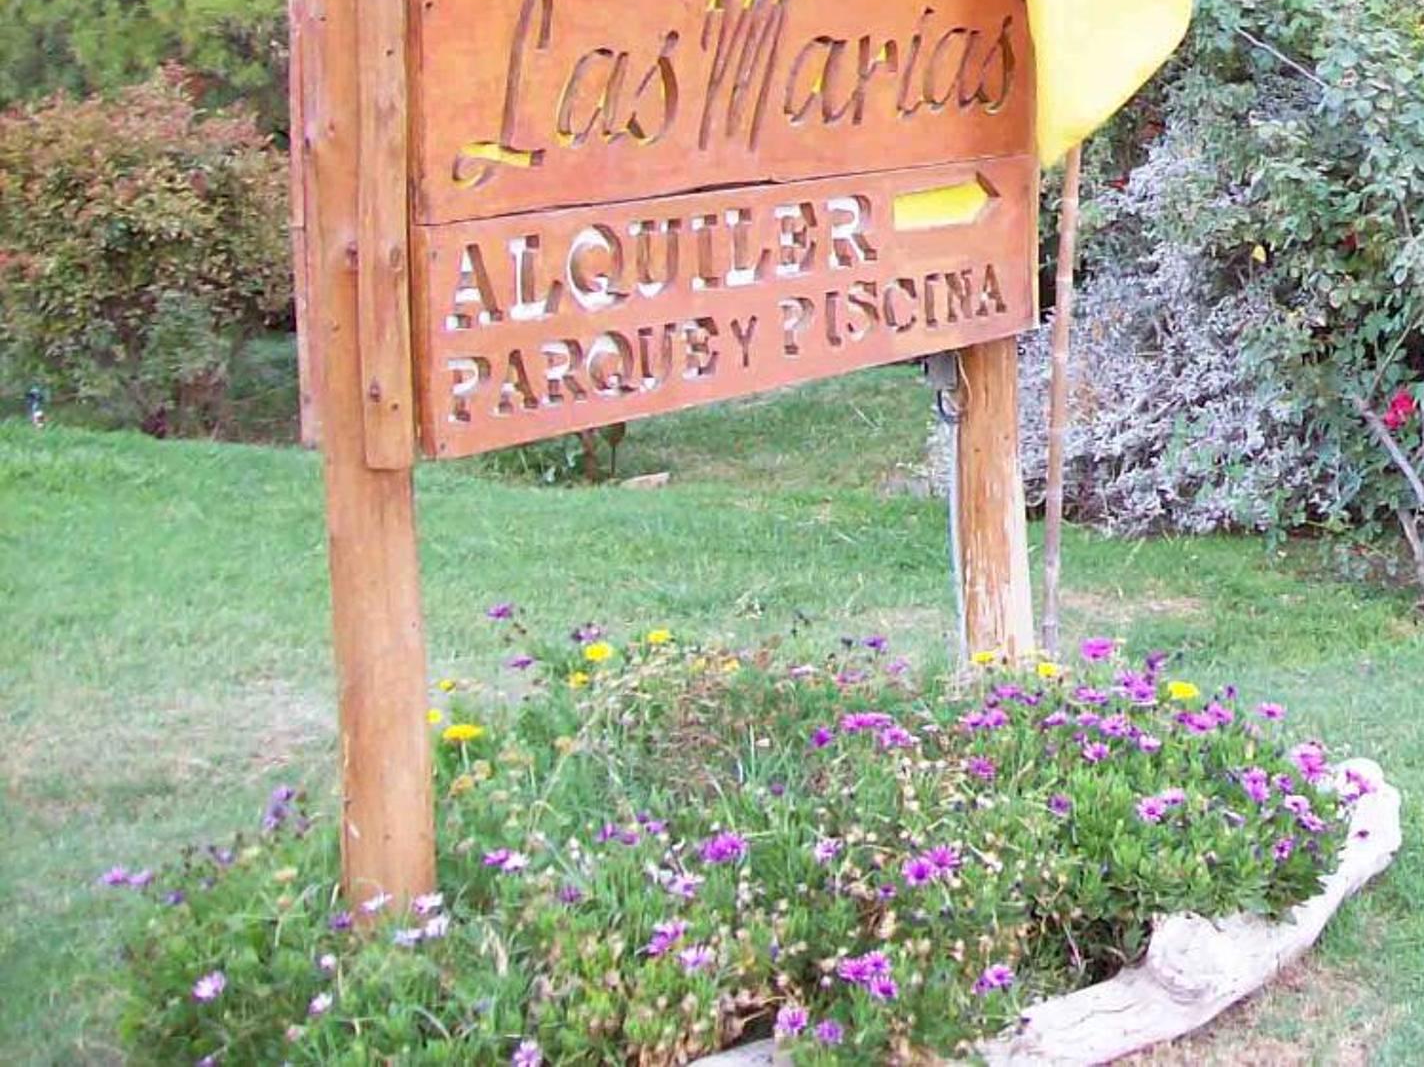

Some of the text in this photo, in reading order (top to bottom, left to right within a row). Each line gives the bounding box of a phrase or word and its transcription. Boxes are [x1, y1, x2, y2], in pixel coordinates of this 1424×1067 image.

[445, 194, 878, 330] ALQUILER
[443, 263, 1007, 422] PARQUE Y PISCINA
